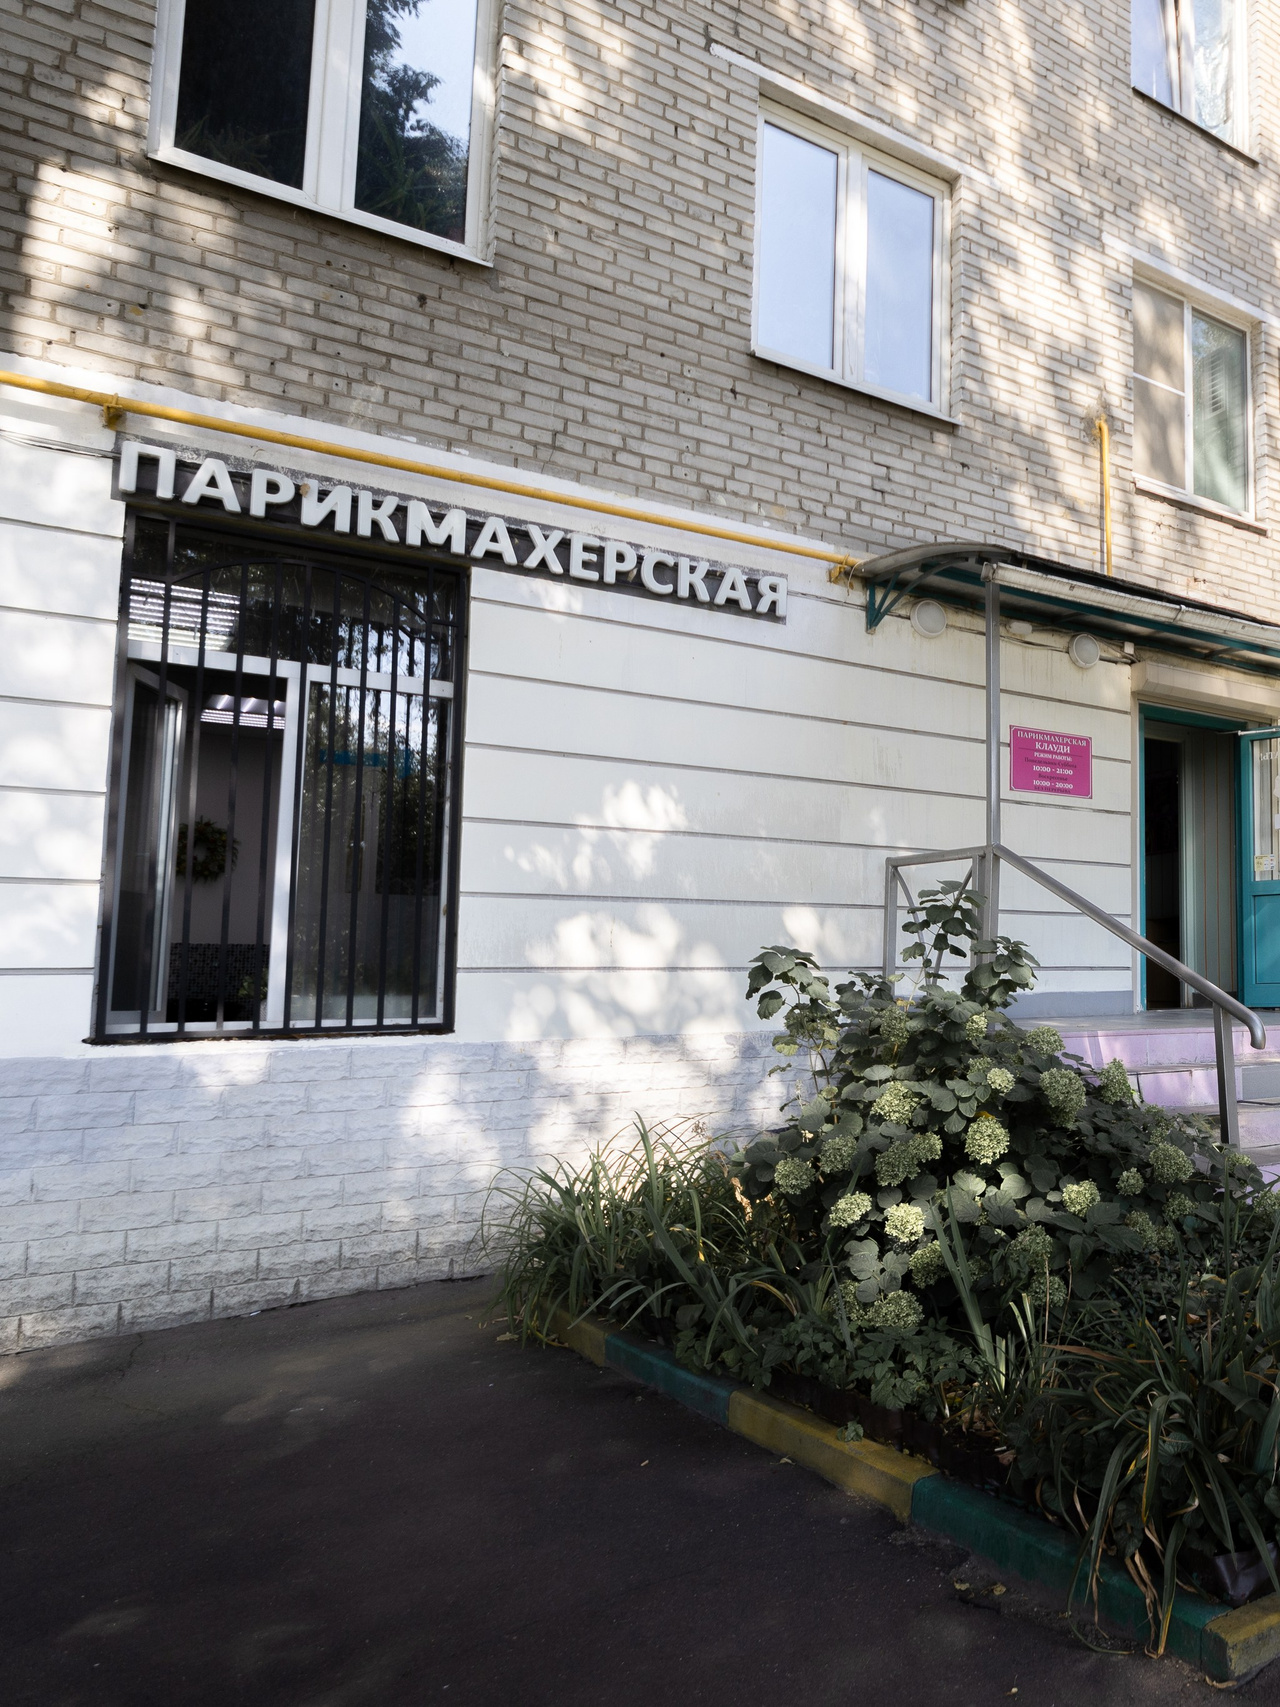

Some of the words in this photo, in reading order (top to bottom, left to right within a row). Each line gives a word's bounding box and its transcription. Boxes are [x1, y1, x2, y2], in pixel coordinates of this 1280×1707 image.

[118, 440, 788, 618] ПАРИКМАХЕРСКАЯ
[1017, 730, 1087, 747] ПАРИКМАХЕРСКАЯ
[1035, 742, 1070, 754] КЛАУДИ
[1034, 751, 1052, 759] РЕЖИМ
[1032, 765, 1051, 773] 10:00
[1033, 779, 1051, 787] 10:00
[1055, 782, 1073, 790] 20:00
